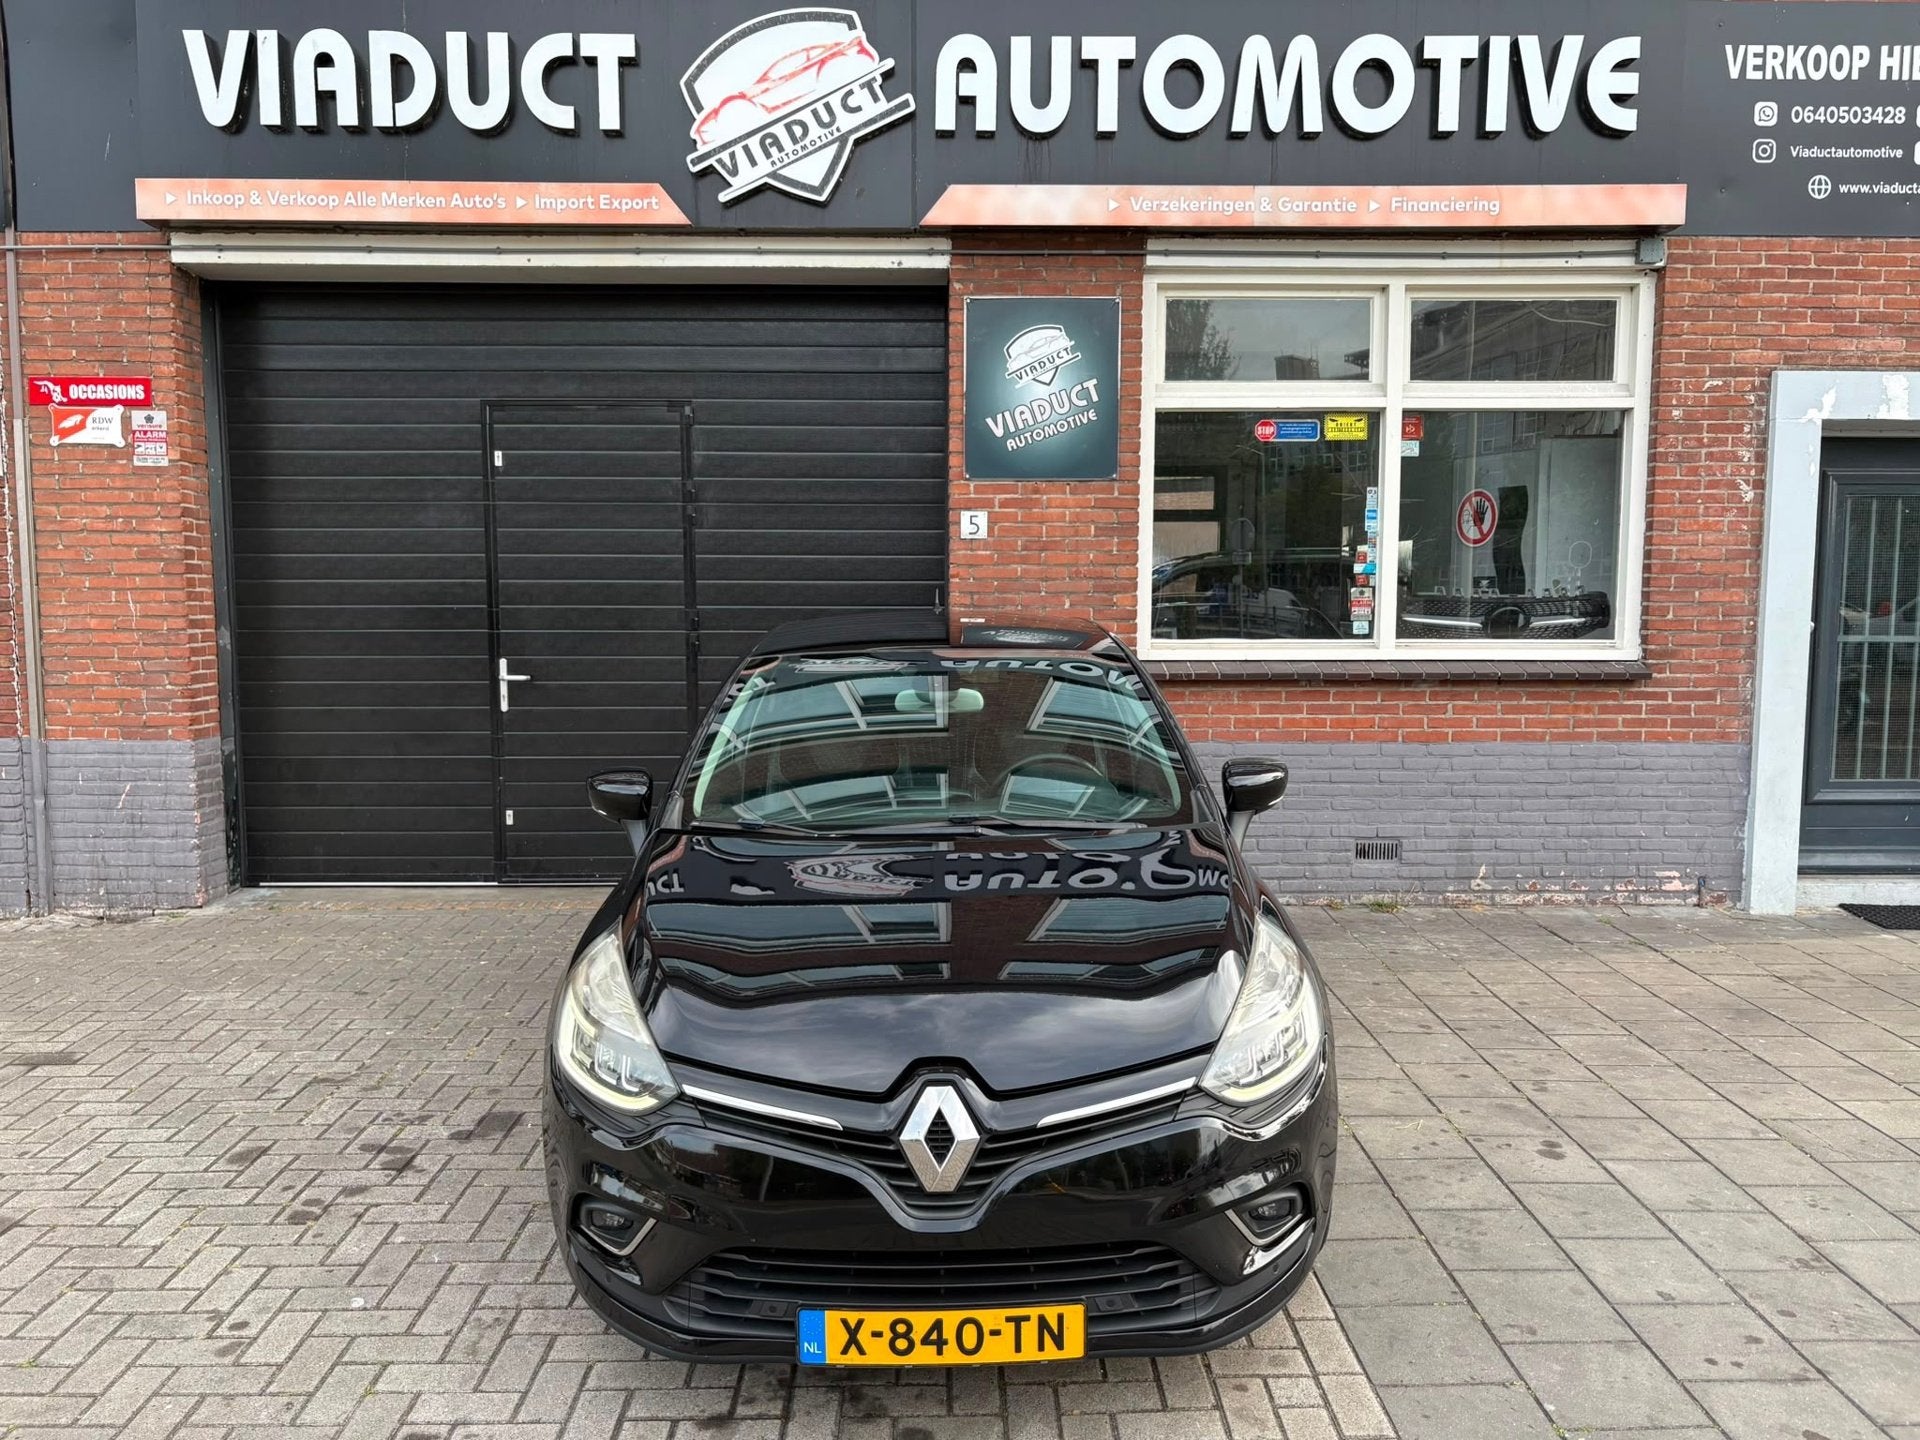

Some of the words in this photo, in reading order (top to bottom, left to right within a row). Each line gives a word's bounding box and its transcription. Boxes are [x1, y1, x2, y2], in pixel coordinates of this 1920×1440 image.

[1725, 44, 1870, 81] VERKOOP
[182, 28, 637, 132] VIADUCT
[935, 33, 1642, 135] AUTOMOTIVE
[1791, 105, 1906, 124] 0640503428
[714, 77, 882, 178] VIADUCT
[770, 126, 843, 168] AUTOMOTIVE
[1790, 145, 1903, 158] Viaductautomotive
[187, 190, 245, 208] Inkoop
[250, 190, 263, 206] &
[268, 190, 339, 210] Verkoop
[344, 190, 377, 207] Alle
[382, 192, 446, 208] Merken
[451, 192, 506, 209] Auto's
[535, 194, 595, 212] Import
[600, 194, 660, 212] Export
[1130, 197, 1255, 214] Verzekeringen
[1260, 197, 1273, 212] &
[1278, 197, 1357, 213] Garantie
[1391, 197, 1501, 215] Financiering
[1015, 347, 1071, 382] VIADUCT
[69, 384, 145, 400] OCCASIONS
[985, 378, 1100, 438] VIADUCT
[92, 416, 114, 425] RDW
[1006, 408, 1098, 452] AUTOMOTIVE
[134, 430, 167, 439] ALARM
[968, 514, 980, 536] 5
[839, 1312, 1065, 1357] X-840-TN
[803, 1342, 822, 1354] NL
